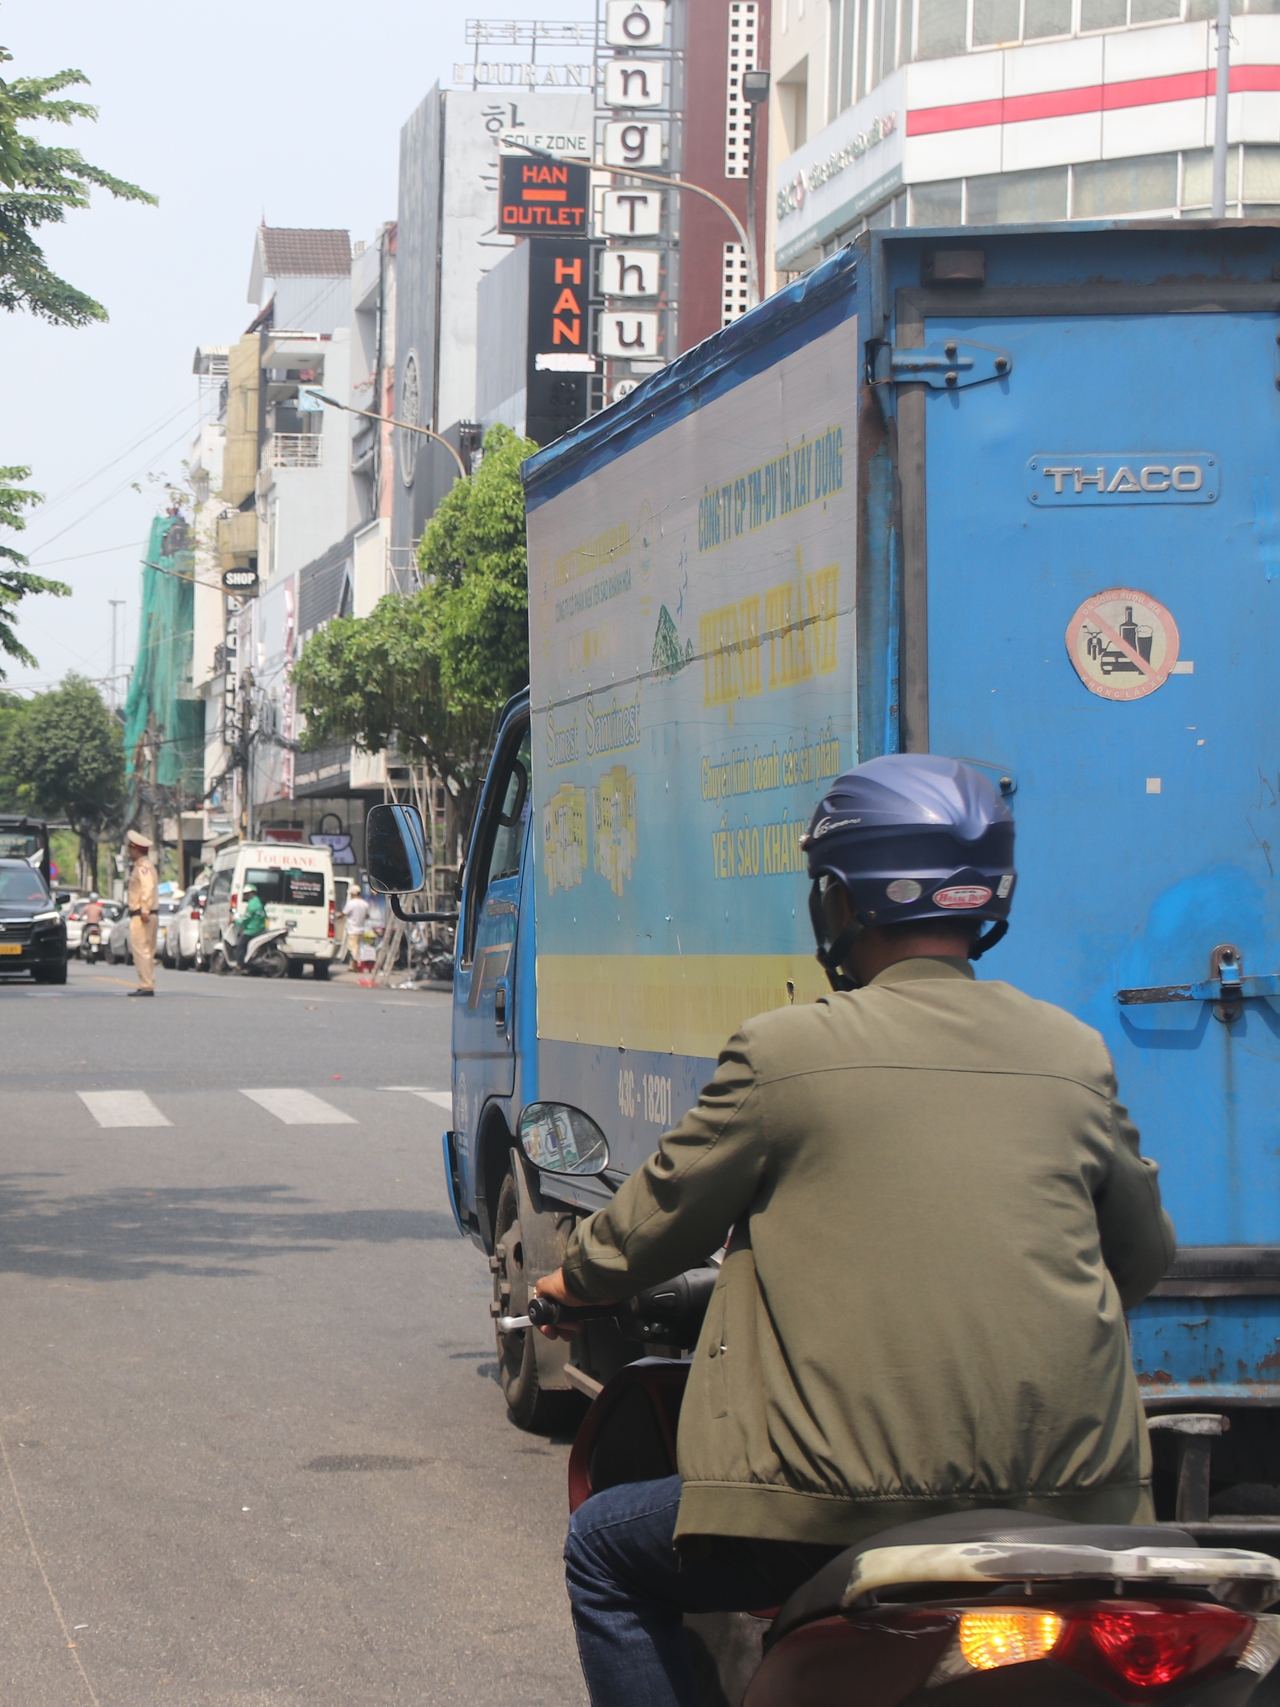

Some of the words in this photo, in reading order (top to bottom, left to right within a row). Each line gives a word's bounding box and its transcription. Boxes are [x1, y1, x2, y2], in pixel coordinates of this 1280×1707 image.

[546, 135, 586, 150] ZONE
[522, 166, 567, 184] HAN
[502, 208, 585, 226] OUTLET
[553, 258, 581, 346] HAN
[698, 483, 721, 553] CÔNG
[722, 482, 733, 542] TY
[734, 475, 747, 538] CP
[779, 439, 793, 518] VÀ
[793, 432, 812, 511] XÂY
[814, 425, 844, 514] DỰNG
[1043, 465, 1202, 494] THACO
[225, 571, 256, 585] SHOP
[700, 753, 731, 807] Chuyên
[732, 746, 751, 797] kinh
[752, 739, 780, 793] doanh
[782, 736, 799, 789] các
[711, 809, 735, 880] YẾN
[736, 813, 760, 879] SÀO
[762, 807, 807, 876] KHÁNH
[256, 850, 316, 867] TOURANE
[642, 1074, 672, 1127] 18201
